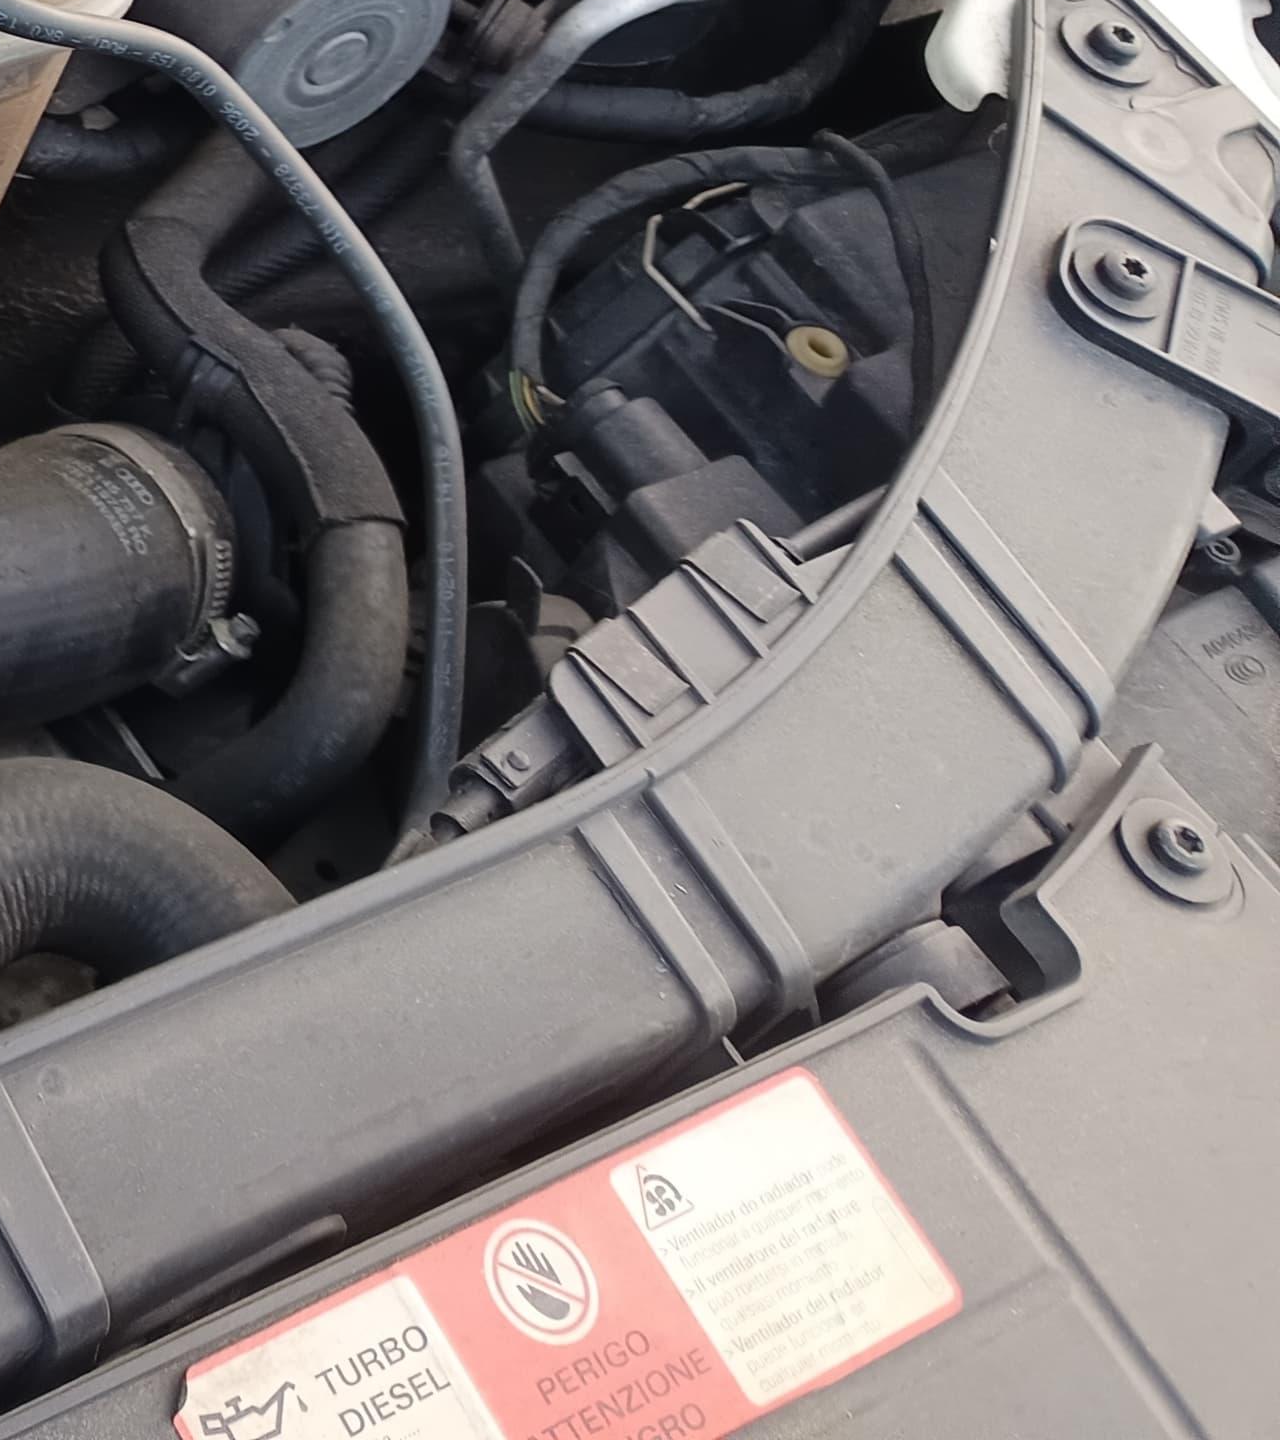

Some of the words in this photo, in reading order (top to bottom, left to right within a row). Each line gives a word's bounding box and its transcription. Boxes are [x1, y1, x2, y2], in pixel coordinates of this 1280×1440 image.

[667, 1206, 737, 1252] Ventilador
[736, 1195, 759, 1217] do
[757, 1166, 815, 1207] radiador
[729, 1305, 805, 1355] Ventilador
[826, 1261, 888, 1304] radiador
[315, 1326, 428, 1395] TURBO
[527, 1348, 712, 1440] TTENZIONE
[536, 1331, 649, 1405] PERIGO
[338, 1368, 451, 1437] DIESEL
